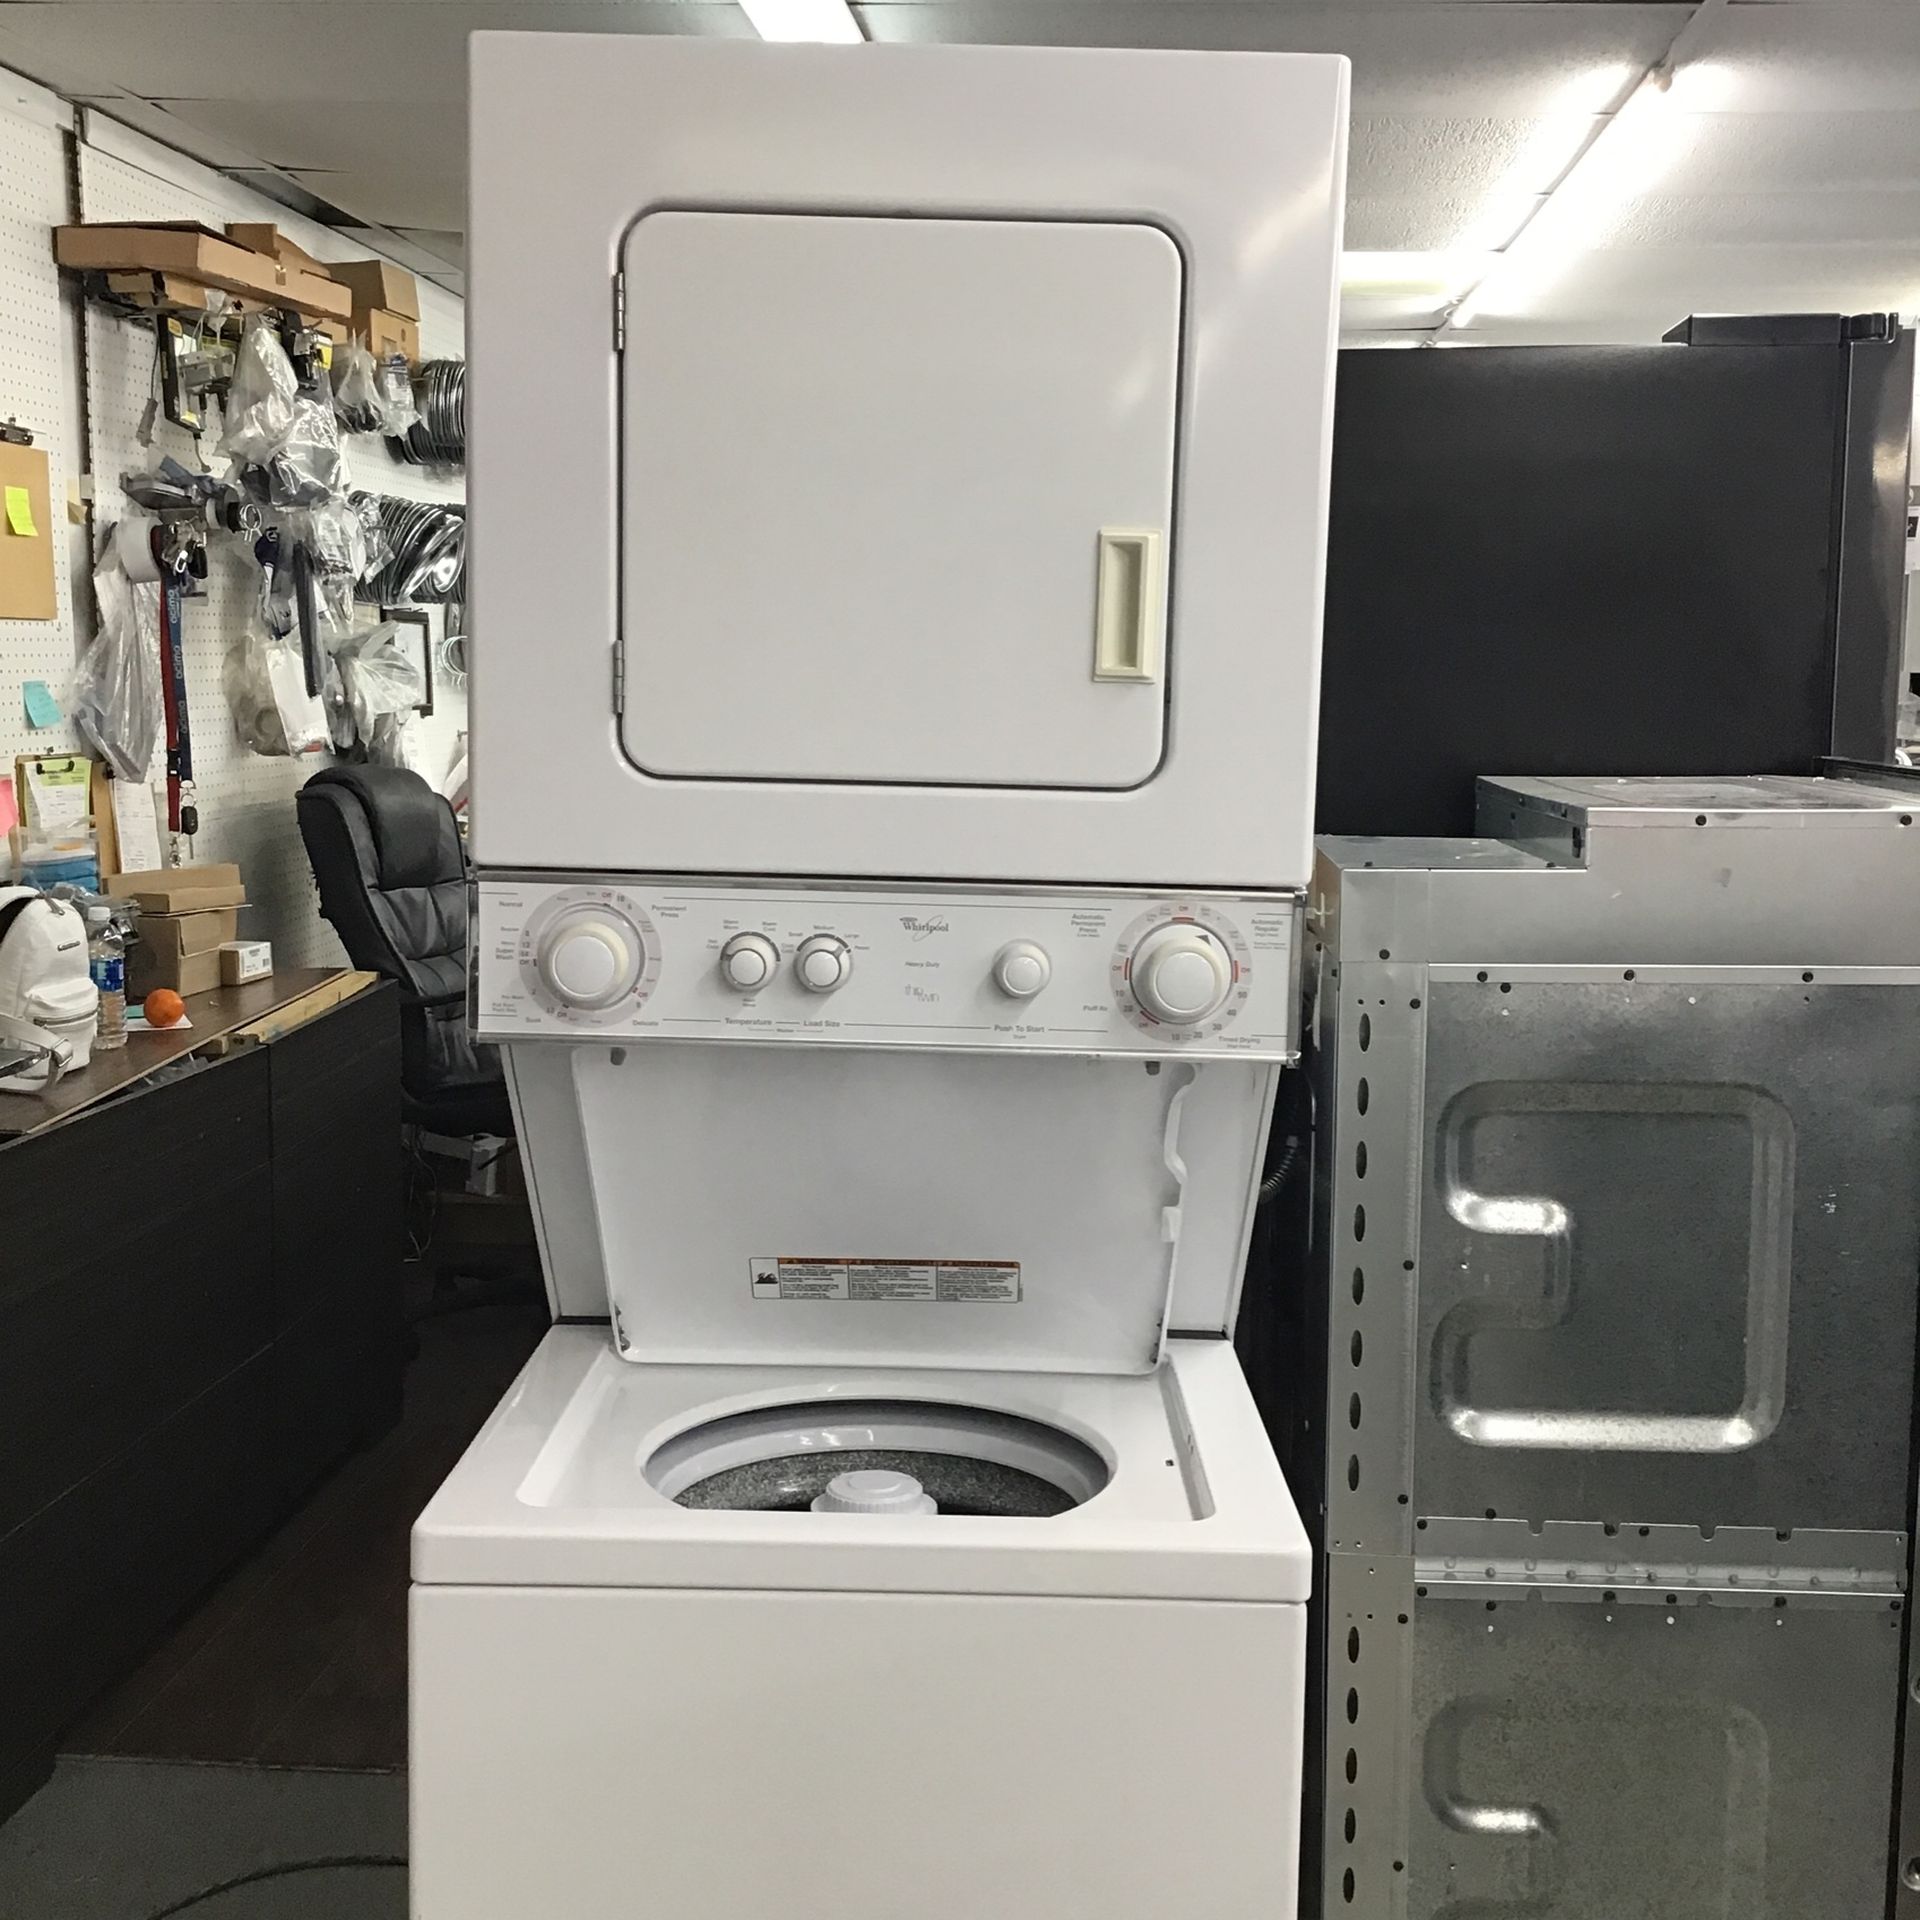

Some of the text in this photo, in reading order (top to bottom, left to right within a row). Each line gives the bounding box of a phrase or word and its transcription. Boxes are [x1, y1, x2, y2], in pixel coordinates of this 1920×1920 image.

[900, 917, 949, 934] Whirlpool
[725, 1017, 772, 1026] Temperature
[994, 1024, 1013, 1032] Push
[1026, 1025, 1045, 1033] Start
